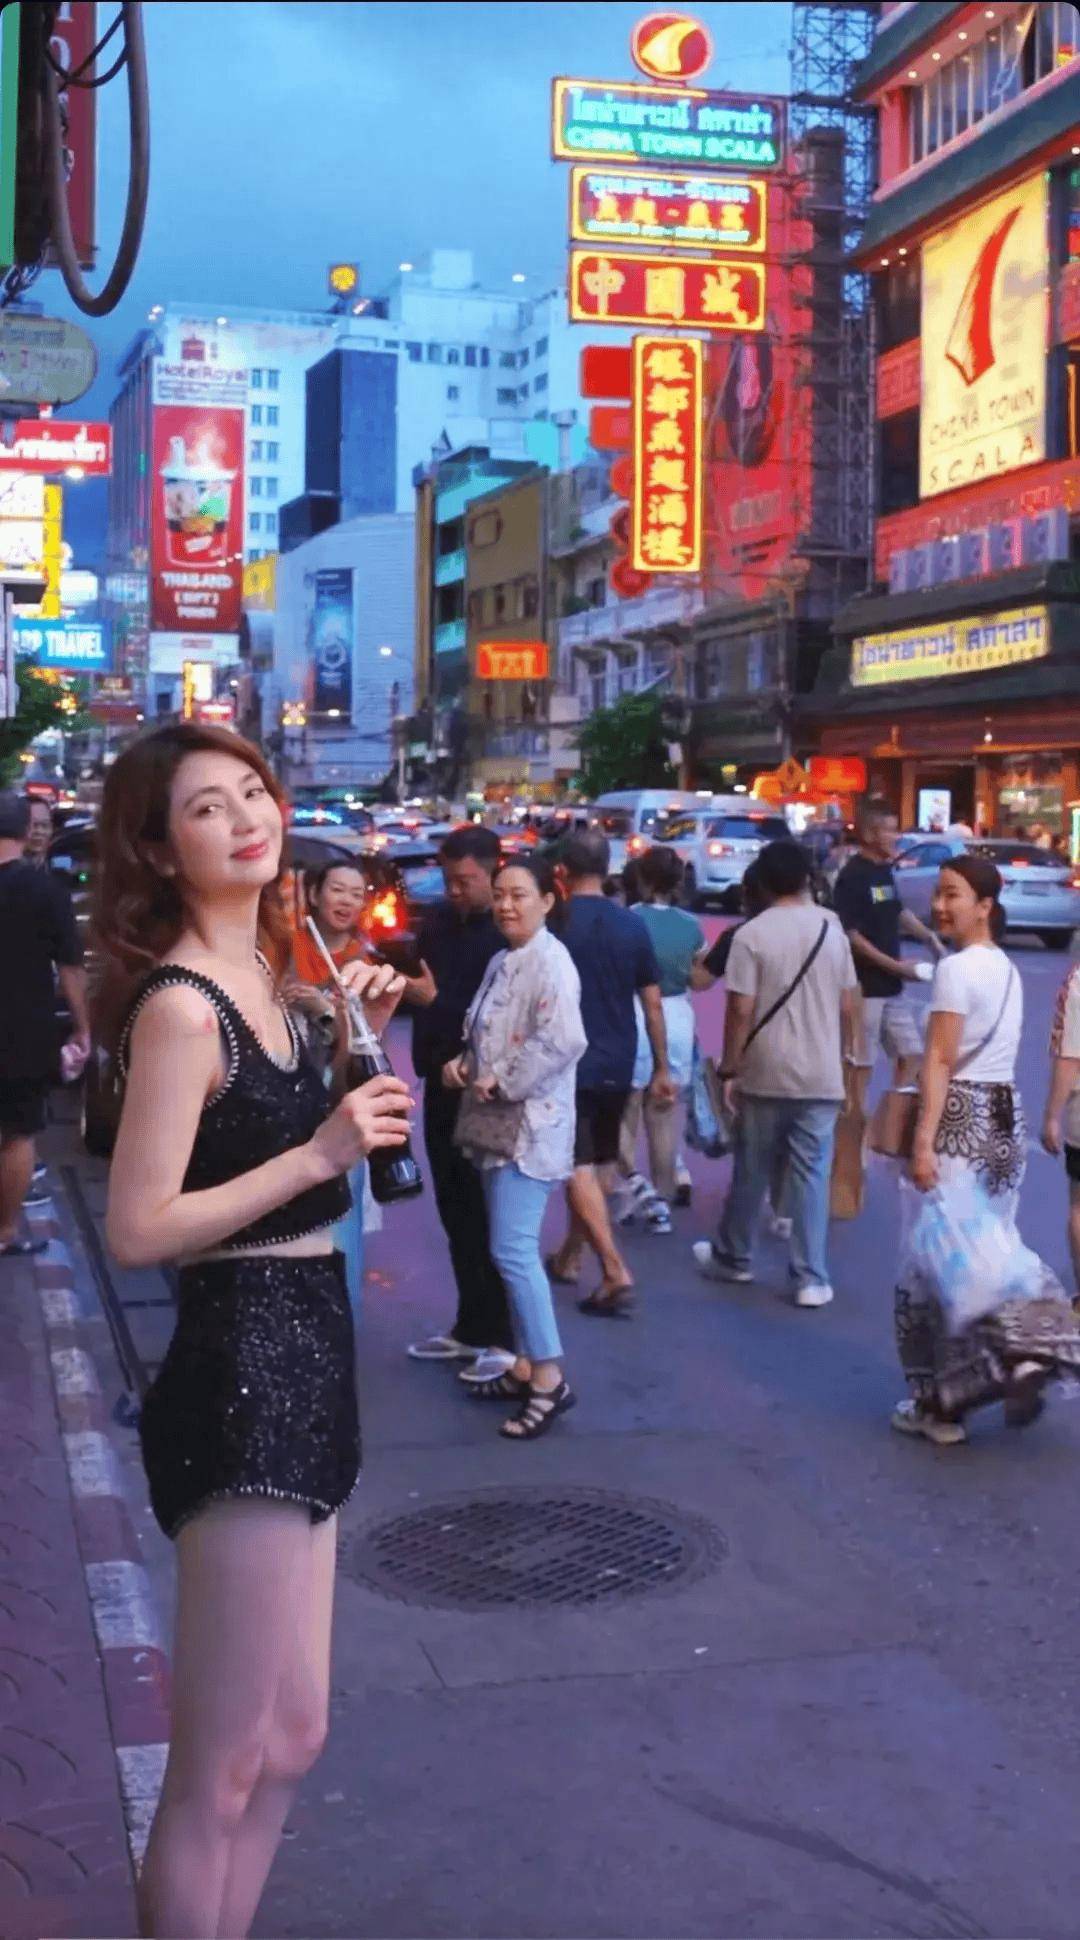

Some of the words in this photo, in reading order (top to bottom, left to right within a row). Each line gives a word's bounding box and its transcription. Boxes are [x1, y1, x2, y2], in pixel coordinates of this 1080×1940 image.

[638, 130, 702, 157] TOWN
[704, 137, 776, 162] SCALA
[929, 409, 980, 446] CHINA
[988, 385, 1037, 422] TOWN
[929, 434, 1036, 489] SCALA
[160, 572, 234, 589] THAILAND
[44, 629, 106, 659] TRAVEL
